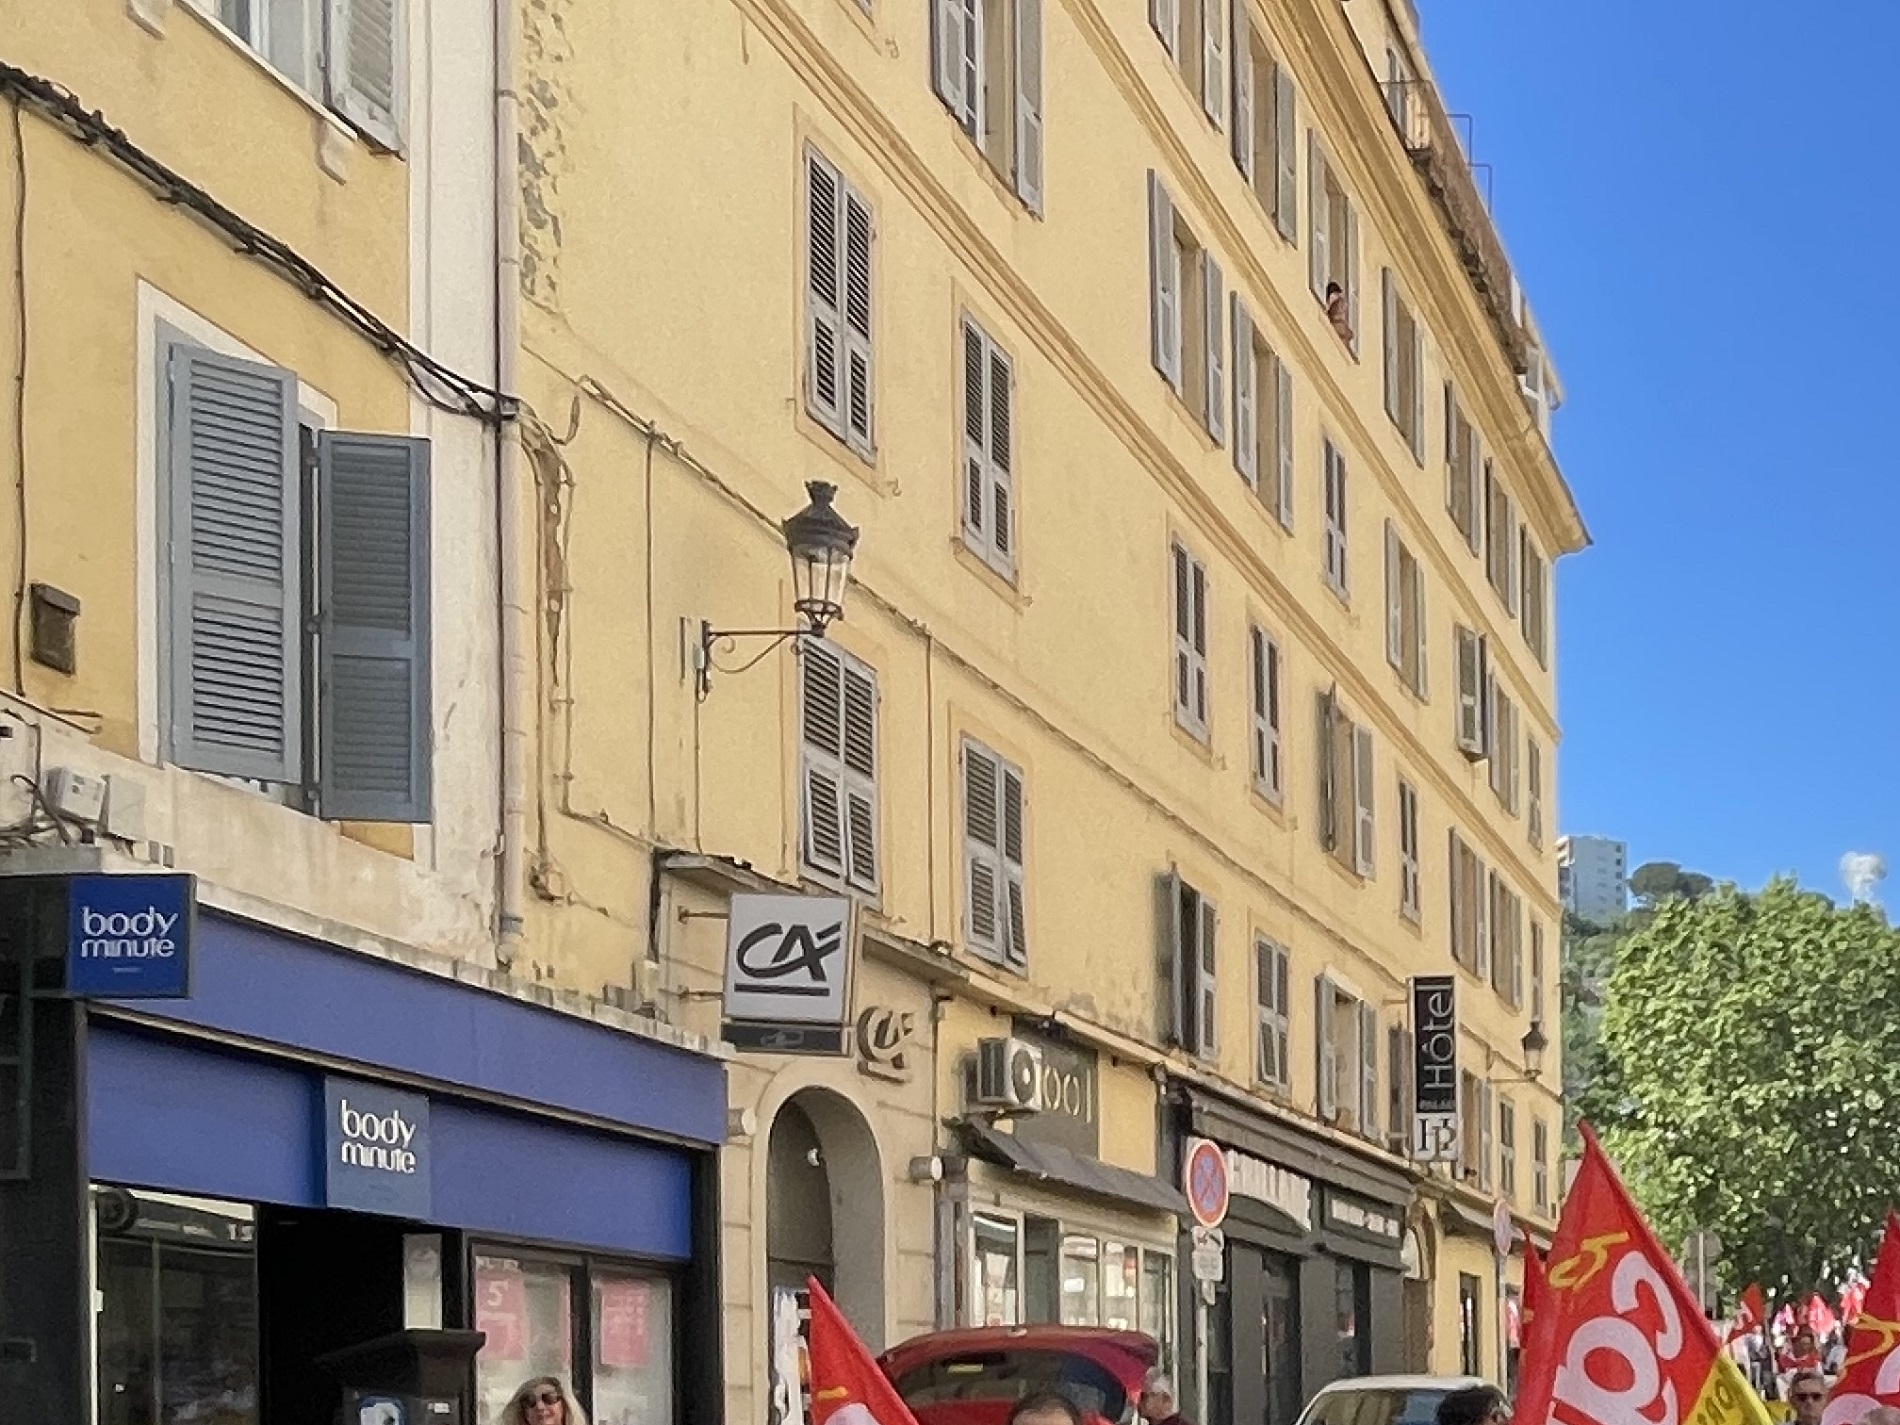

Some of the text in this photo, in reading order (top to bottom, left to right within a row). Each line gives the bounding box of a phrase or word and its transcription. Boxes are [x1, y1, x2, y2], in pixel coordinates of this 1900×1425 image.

[82, 905, 179, 937] body
[81, 937, 175, 958] minute
[1415, 984, 1456, 1090] Hôtel
[340, 1099, 416, 1148] body
[340, 1141, 416, 1174] minute
